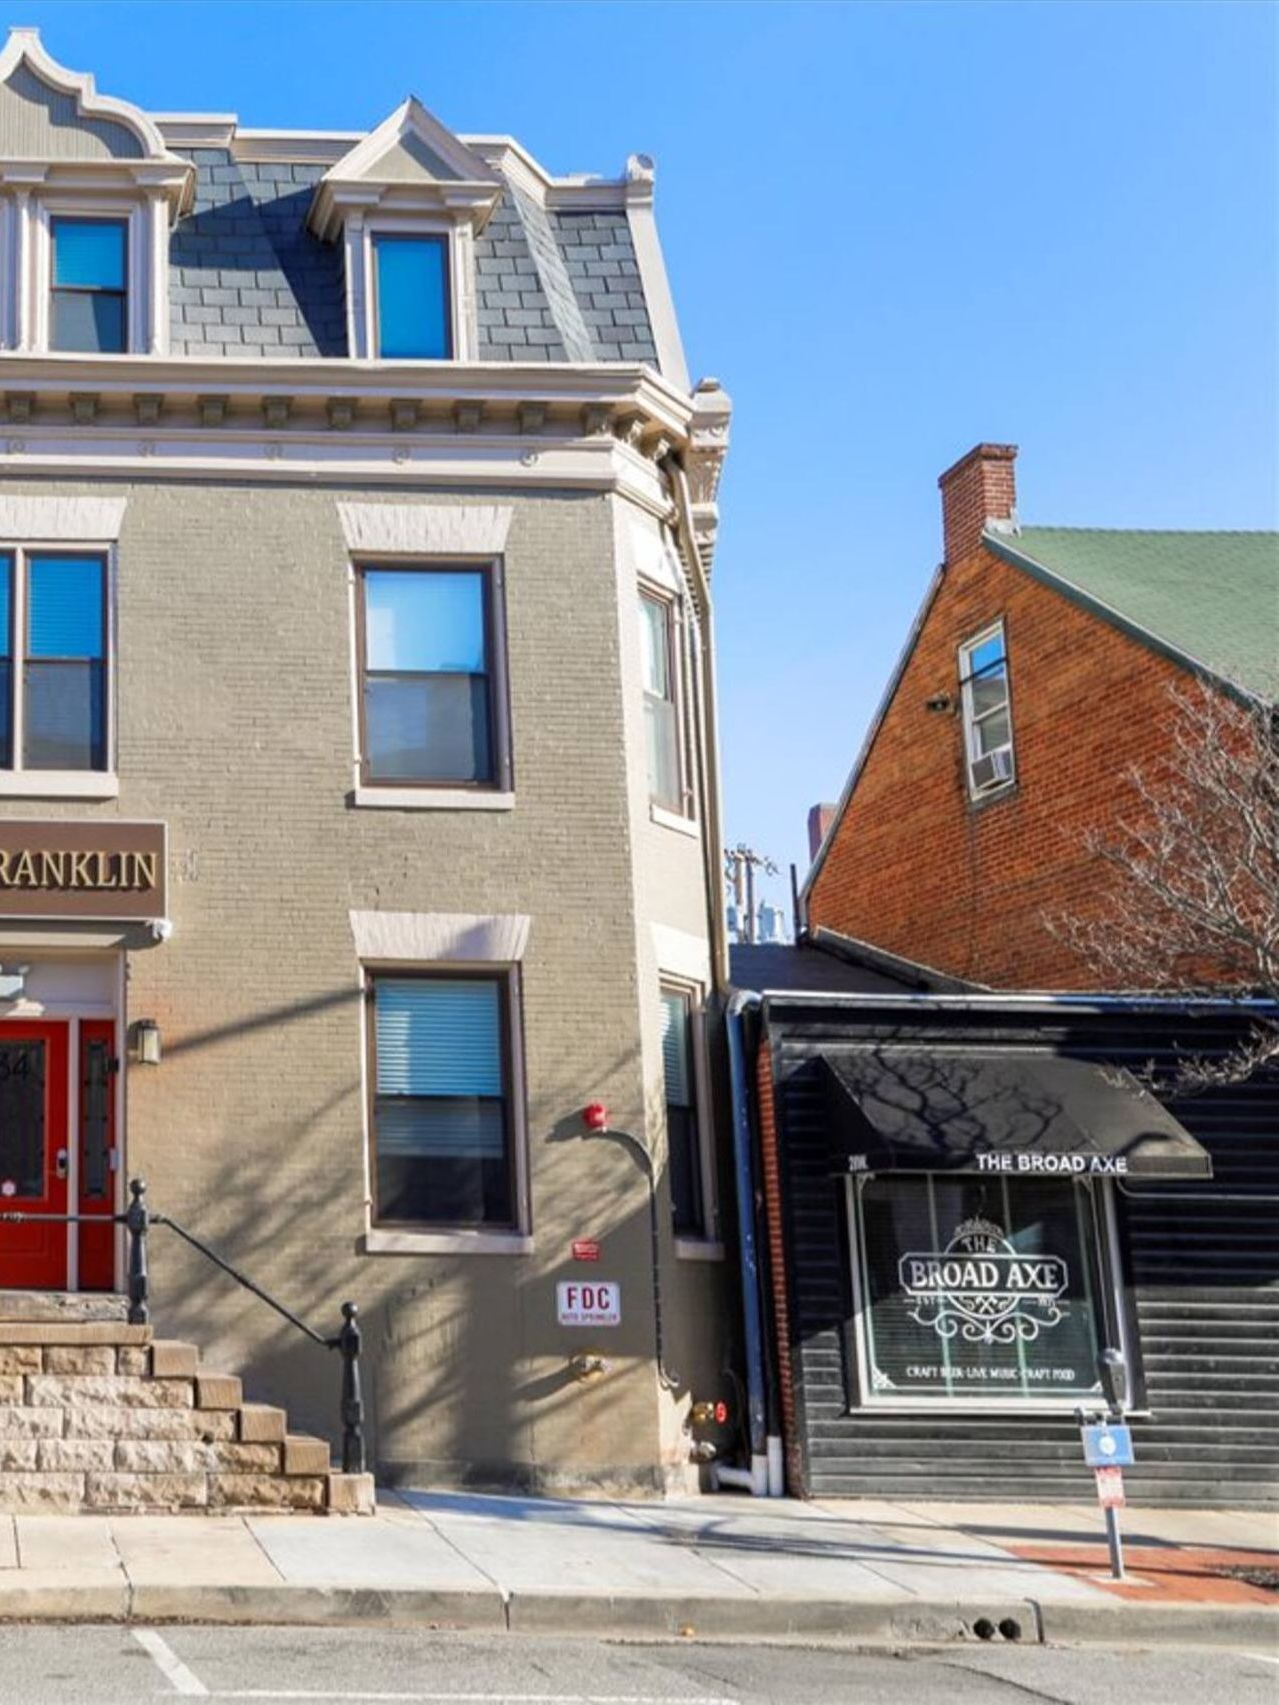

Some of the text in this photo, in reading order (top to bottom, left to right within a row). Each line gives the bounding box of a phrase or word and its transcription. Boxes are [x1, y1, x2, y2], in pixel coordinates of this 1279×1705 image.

[976, 1153, 1128, 1173] THE BROAD AXE
[962, 1237, 998, 1254] THE
[910, 1261, 1059, 1290] BROAD AXE
[567, 1287, 610, 1310] FDC
[906, 1366, 937, 1378] CRAFT
